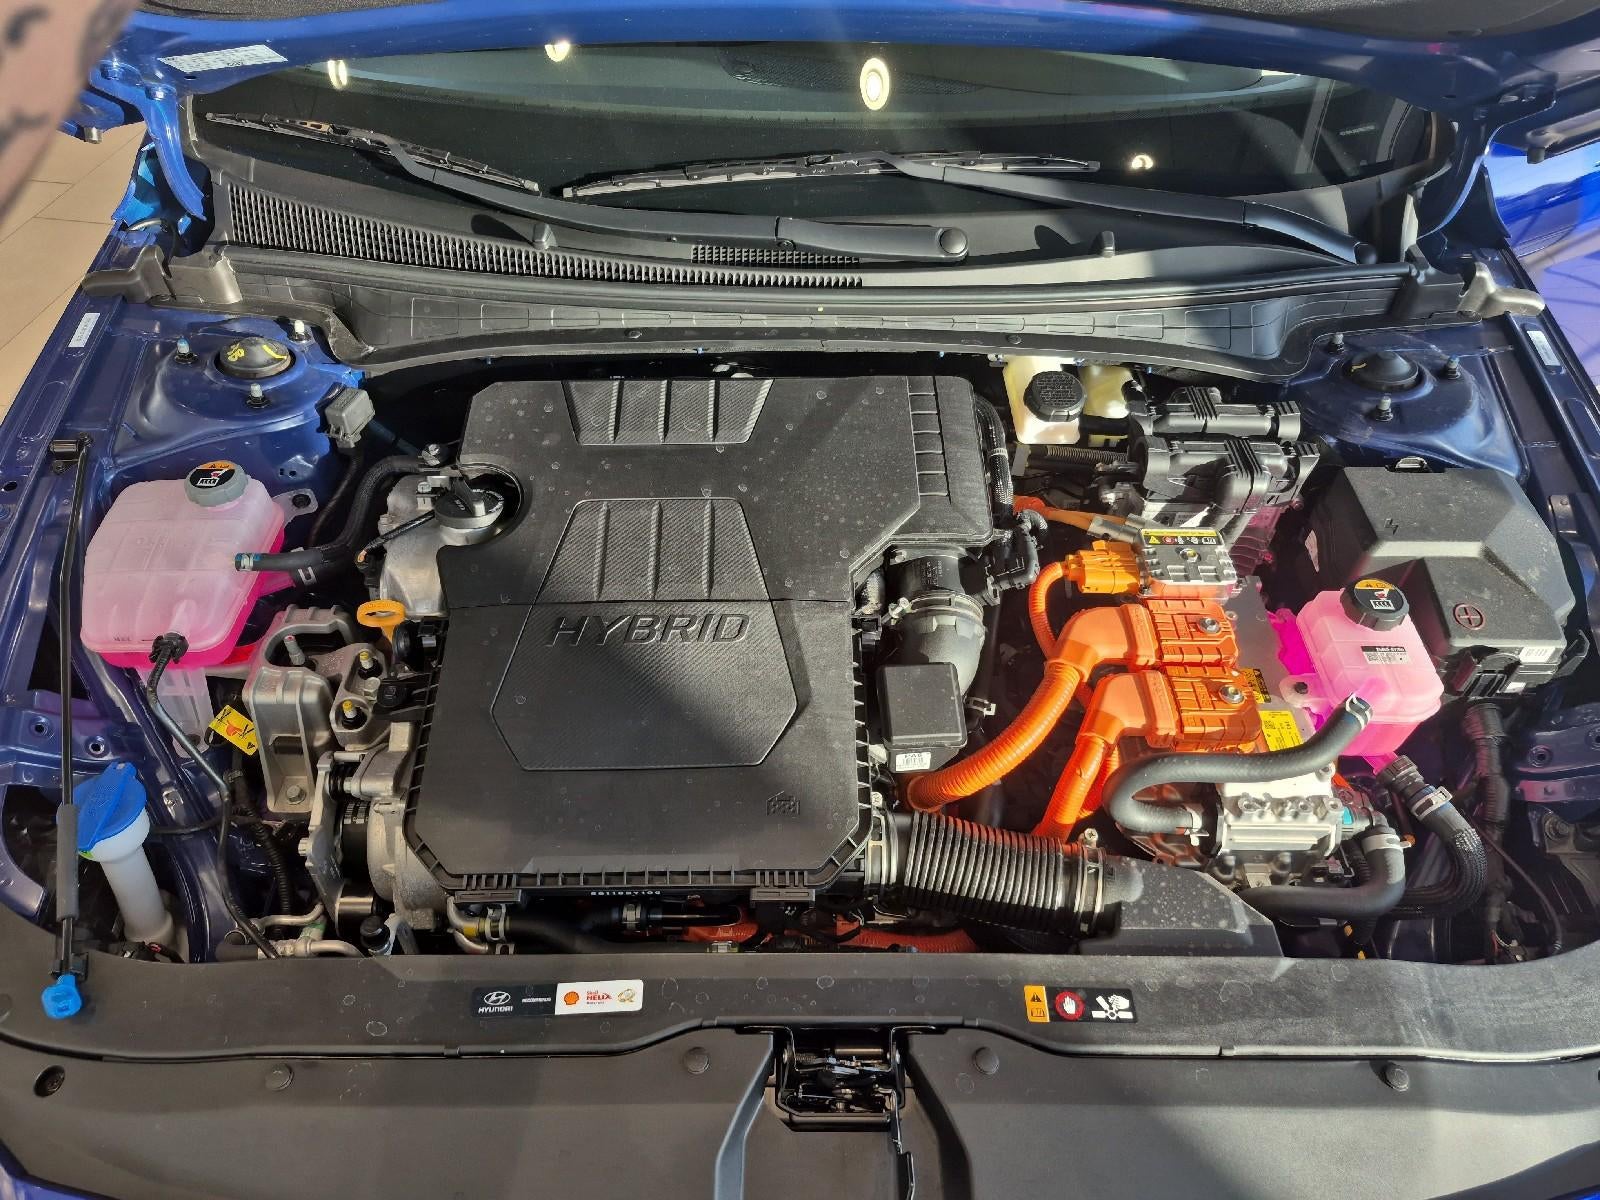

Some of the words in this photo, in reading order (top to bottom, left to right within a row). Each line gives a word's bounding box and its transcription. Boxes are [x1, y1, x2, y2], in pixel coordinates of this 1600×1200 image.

[545, 614, 750, 646] HYBRID
[586, 993, 612, 1001] HELIX
[478, 1005, 514, 1014] HYUNDAI
